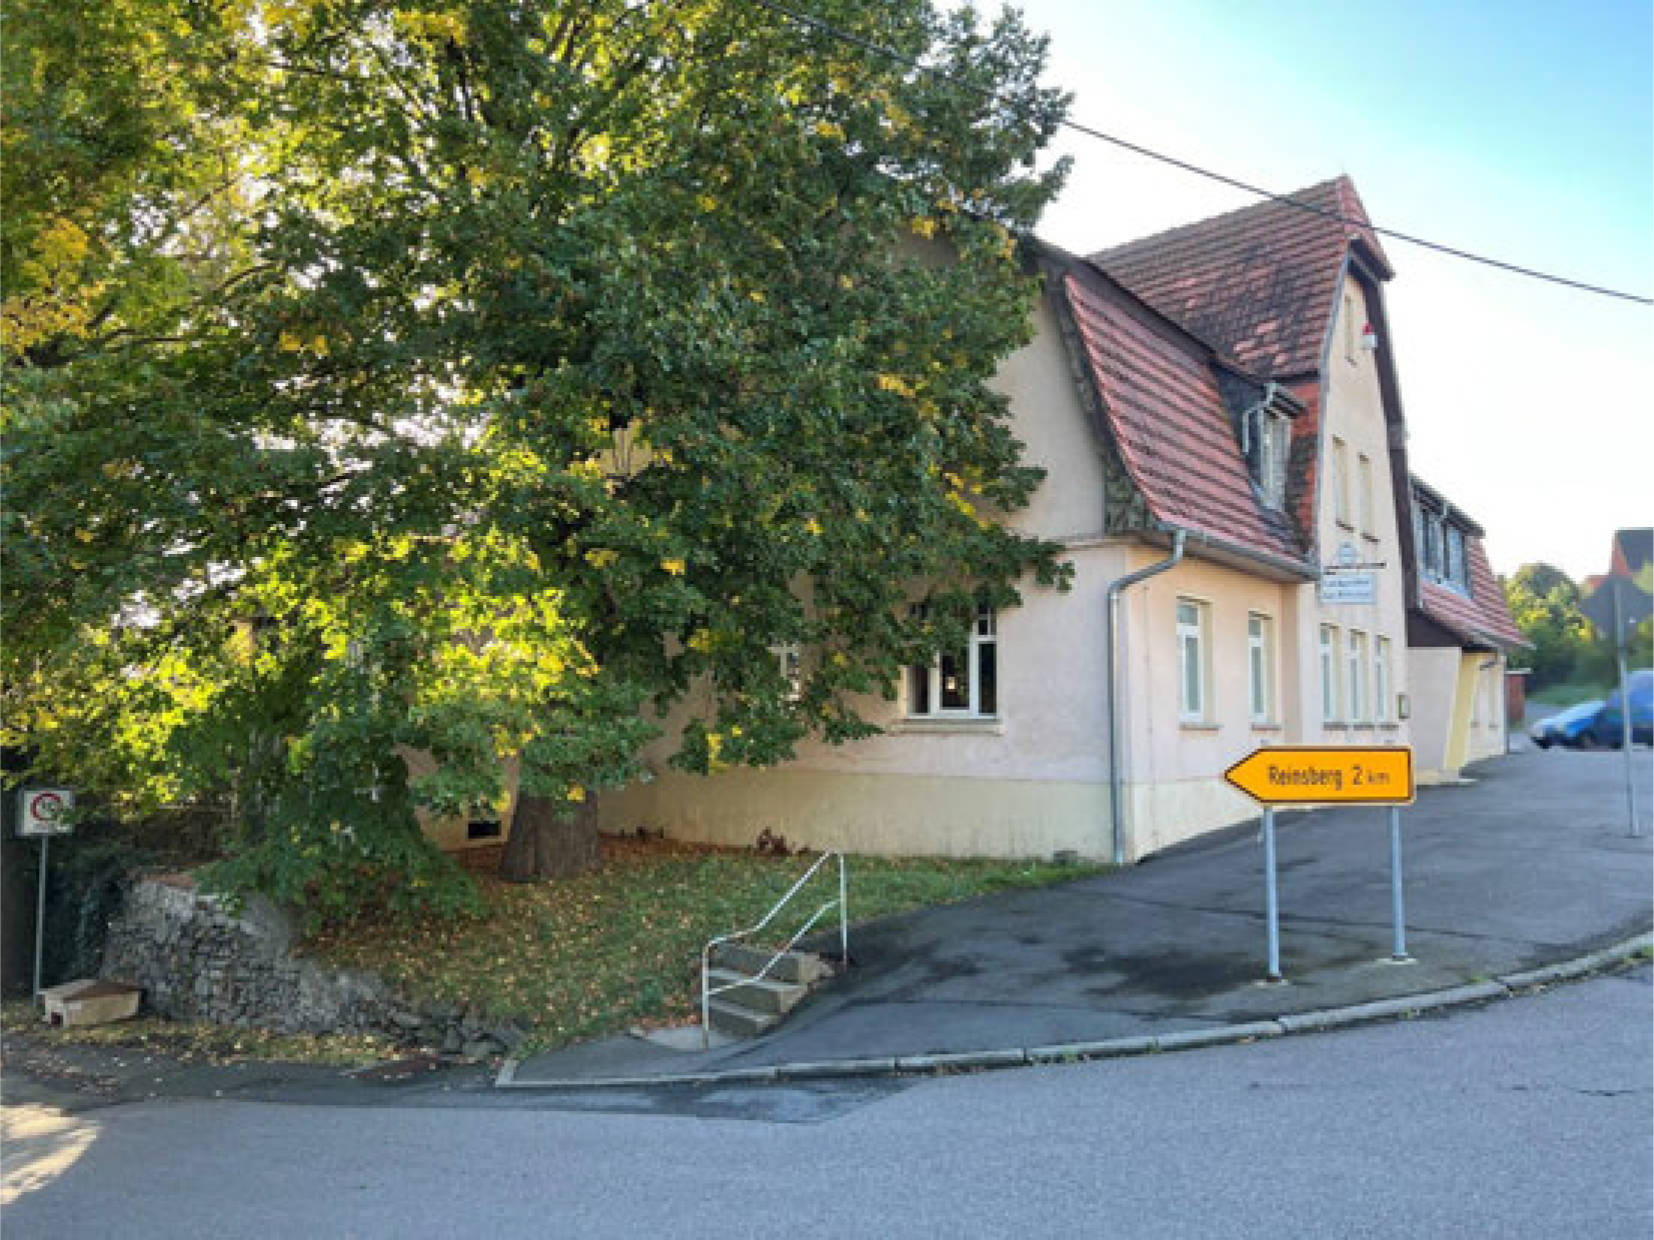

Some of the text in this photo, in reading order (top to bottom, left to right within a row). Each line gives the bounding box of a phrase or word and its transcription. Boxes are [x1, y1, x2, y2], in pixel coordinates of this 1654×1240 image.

[1268, 766, 1390, 791] Reinsberg 2 km
